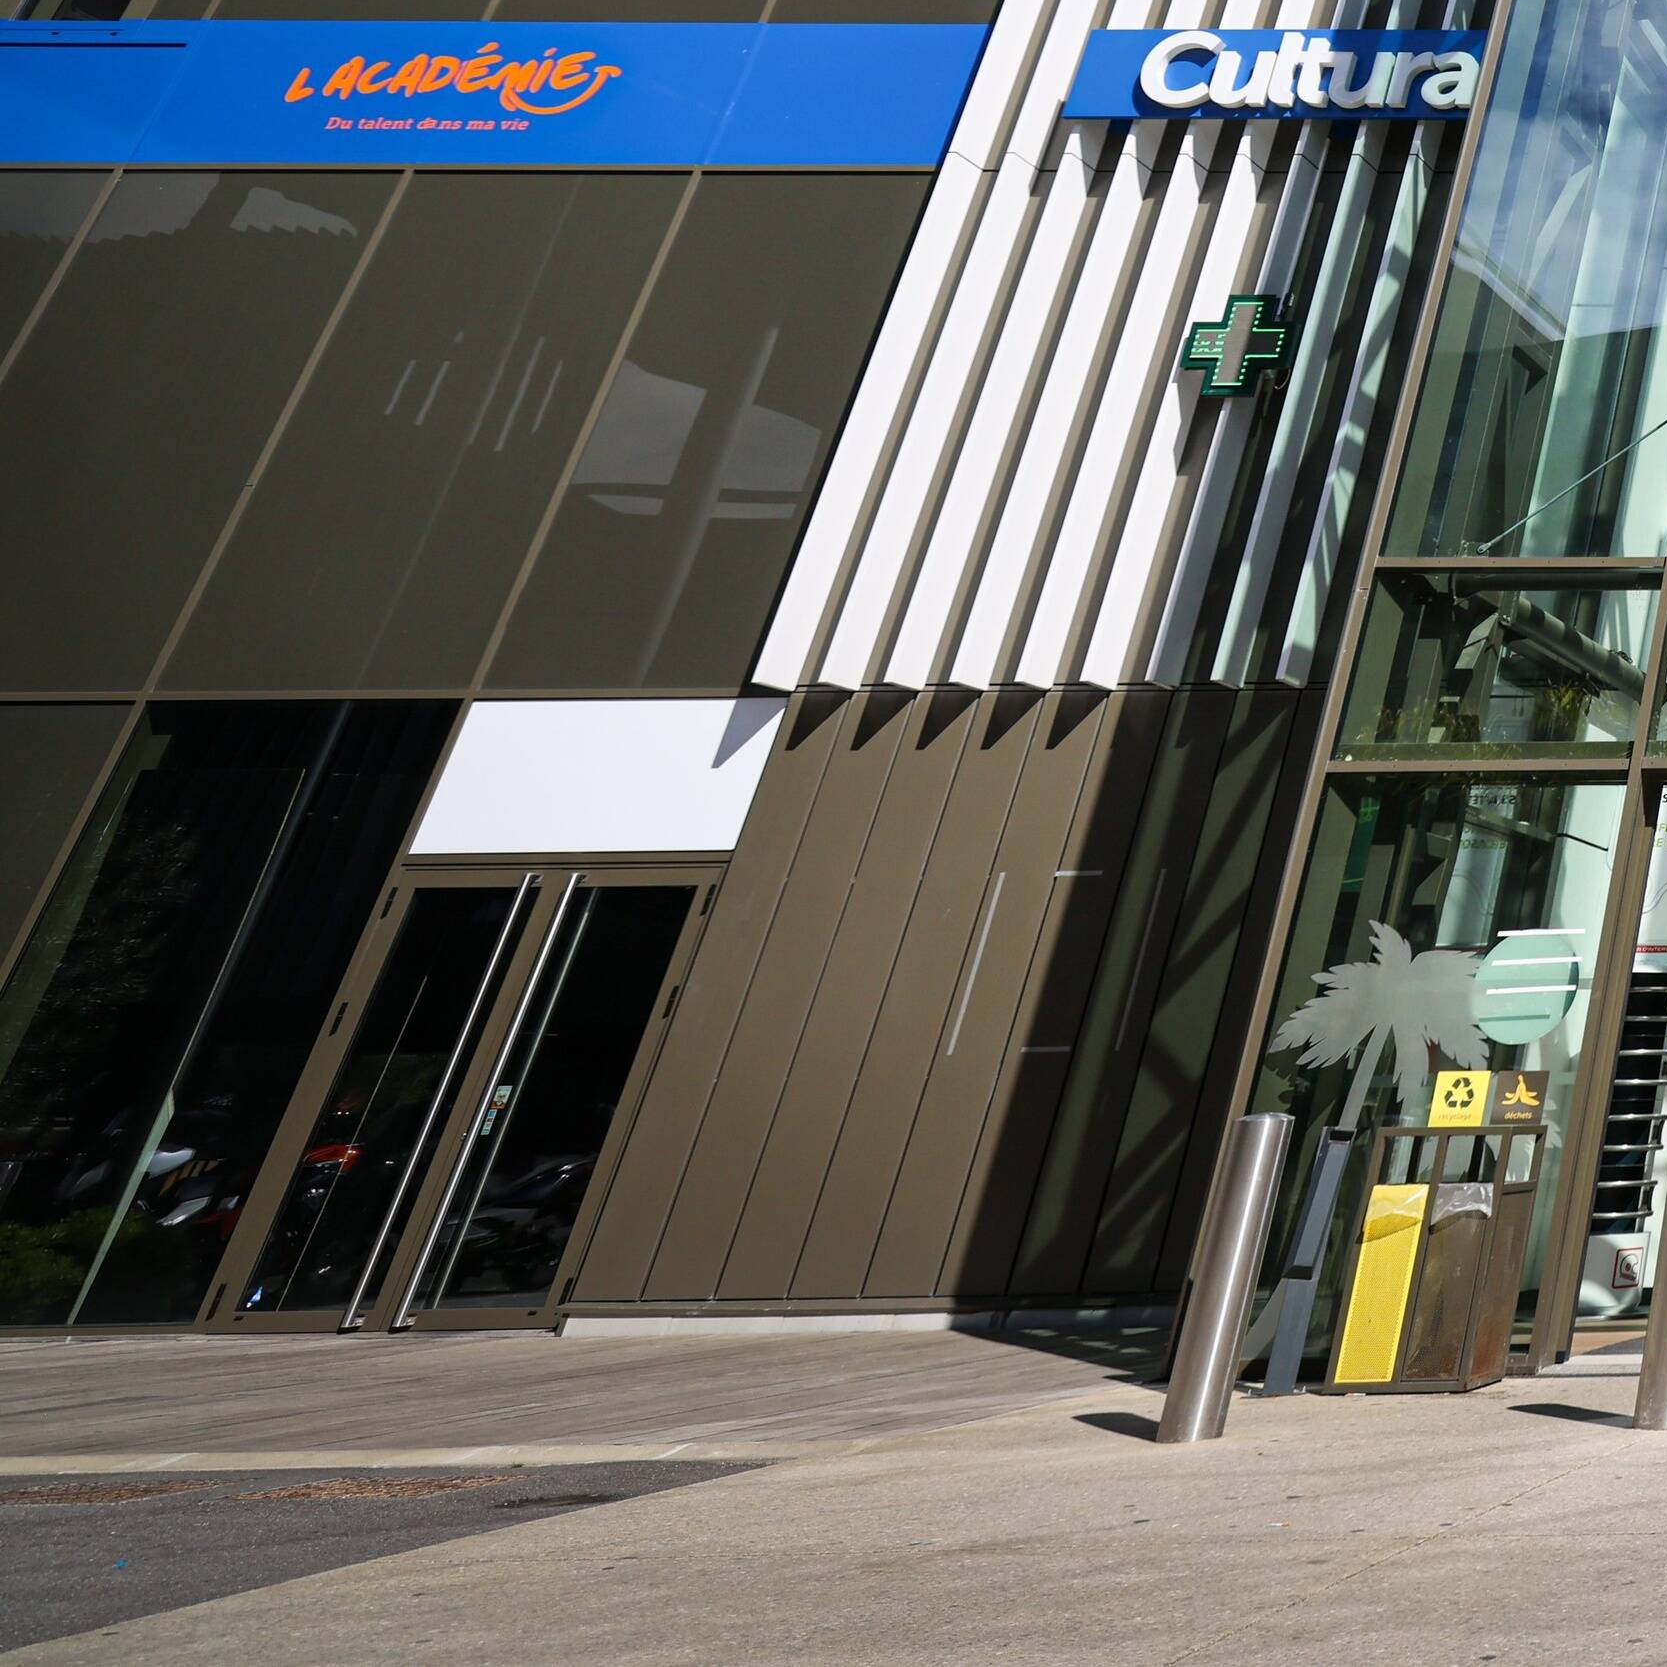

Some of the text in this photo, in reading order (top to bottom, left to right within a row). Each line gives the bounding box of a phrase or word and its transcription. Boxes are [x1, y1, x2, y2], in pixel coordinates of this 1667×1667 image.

[1141, 31, 1480, 109] Cultura
[325, 118, 353, 130] Du
[358, 118, 413, 130] talent
[466, 120, 495, 130] ma
[501, 119, 529, 130] vie
[1504, 1110, 1532, 1120] déchets
